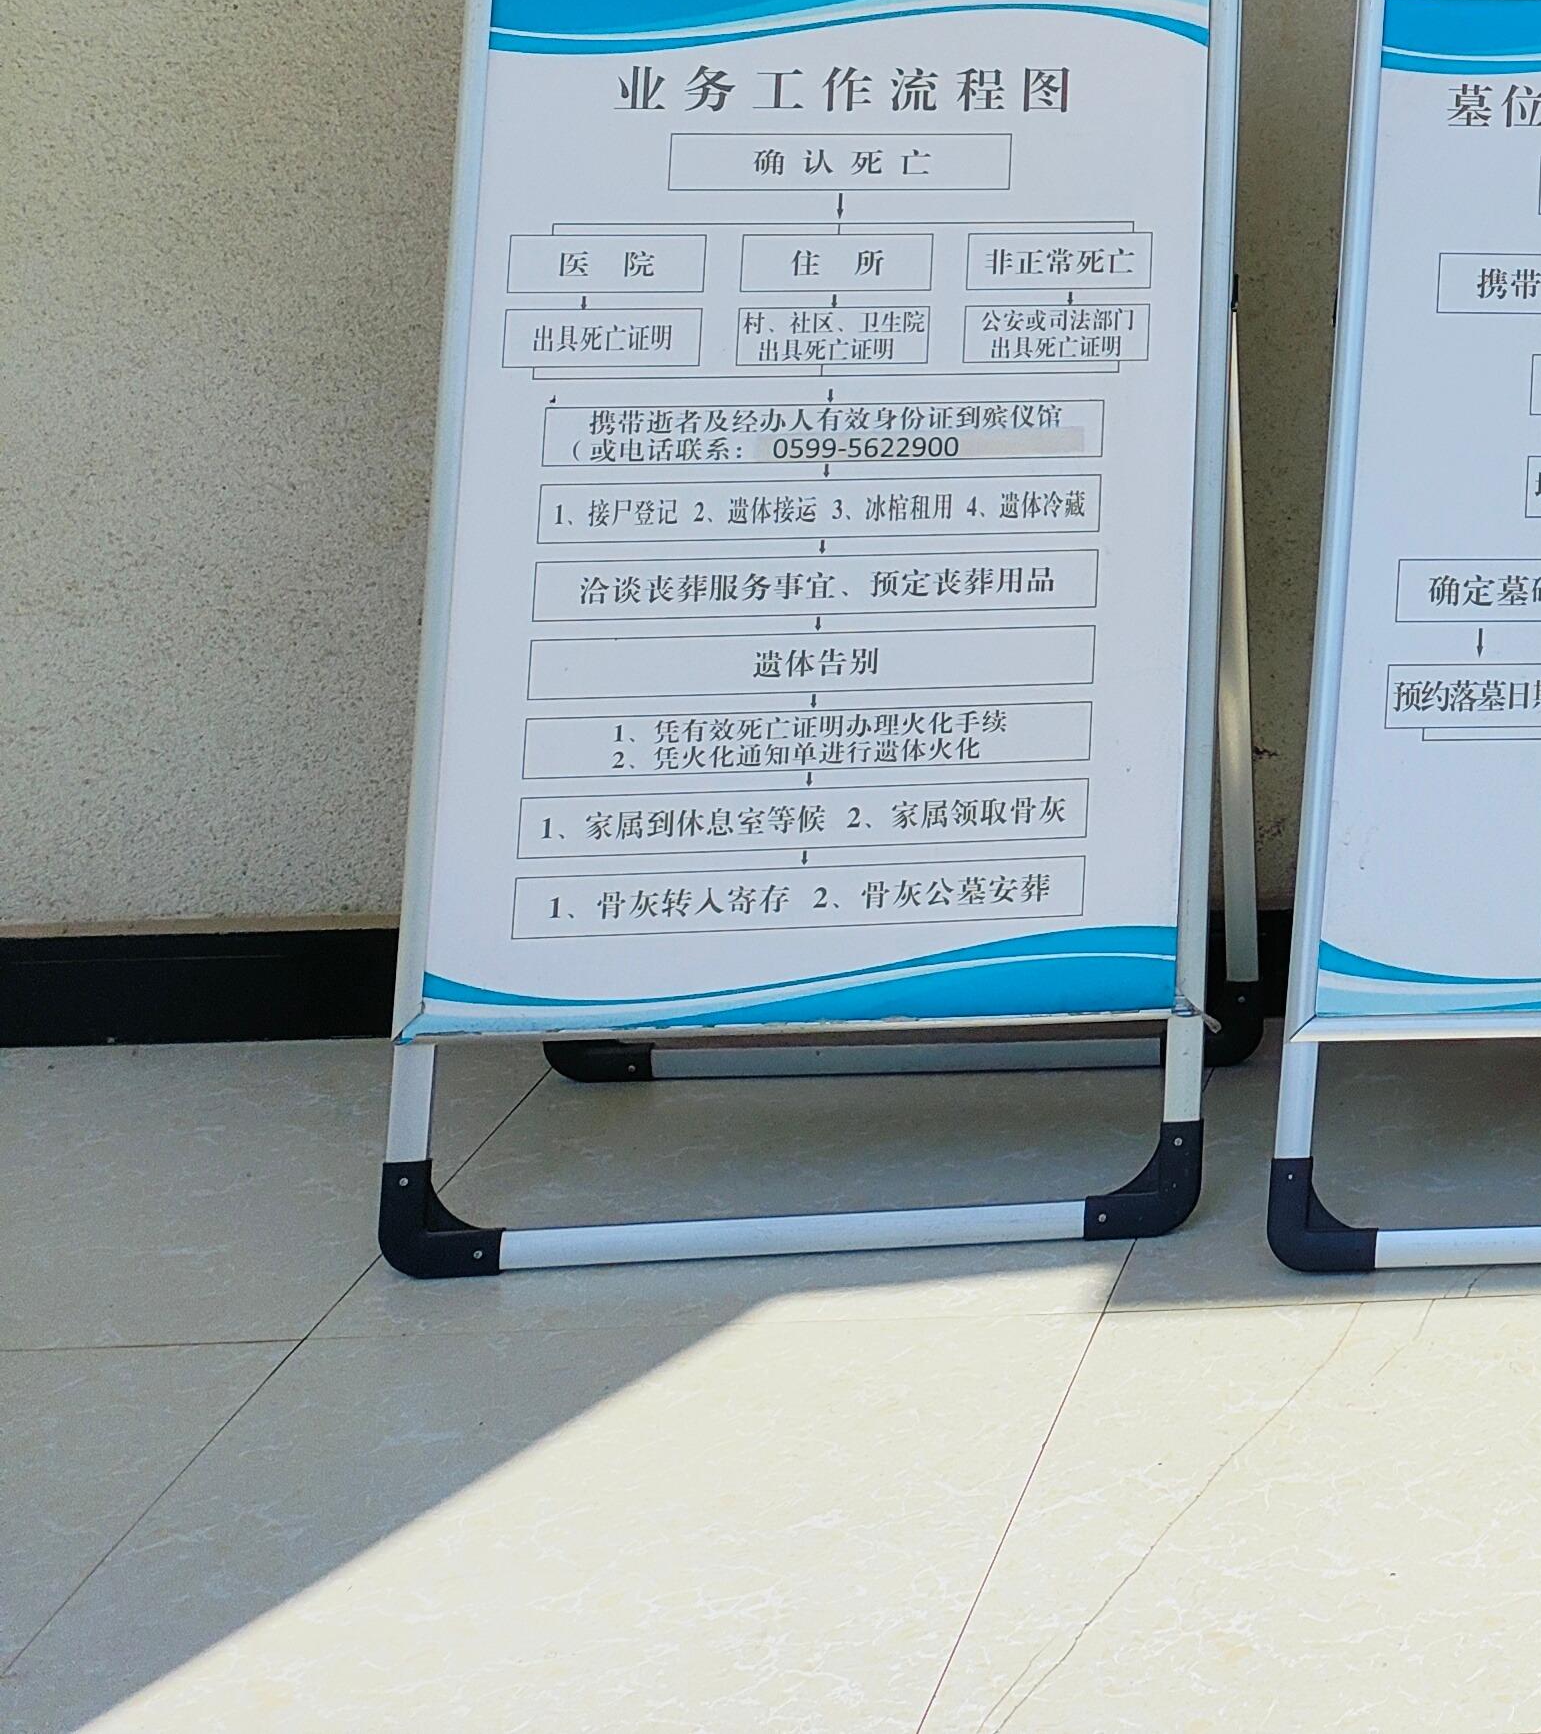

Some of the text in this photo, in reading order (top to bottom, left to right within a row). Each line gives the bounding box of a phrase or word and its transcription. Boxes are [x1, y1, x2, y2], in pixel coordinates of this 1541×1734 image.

[613, 64, 1071, 114] 业务工作流程图
[753, 148, 932, 176] 确认死亡
[557, 250, 656, 278] 医院
[791, 249, 885, 277] 住所
[985, 247, 1136, 276] 非正常死亡
[742, 310, 926, 335] 村、社区、卫生院
[981, 307, 1134, 332] 公安或司法部门
[532, 324, 673, 353] 出具死亡证明
[758, 337, 894, 362] 出具死亡证明
[990, 335, 1122, 359] 出具死亡证明
[588, 403, 1063, 436] 携带逝者及经办人有效身份证到殡仪馆
[572, 436, 960, 463] （或电话联系： 0599-5622900
[554, 489, 1086, 528] 1、接尸登记 2、遗体接运 3、冰棺租用 4、遗体冷藏
[579, 566, 1055, 605] 洽谈丧葬服务事宜、预定丧葬用品
[752, 647, 879, 679] 遗体告别
[613, 709, 1008, 745] 1、凭有效死亡证明办理火化手续
[611, 736, 981, 771] 2、凭火化通知单进行遗体火化
[540, 795, 1067, 841] 1、家属到休息室等候 2、家属领取骨灰
[548, 873, 1051, 920] 1、骨灰转入寄存 2、骨灰公墓安葬
